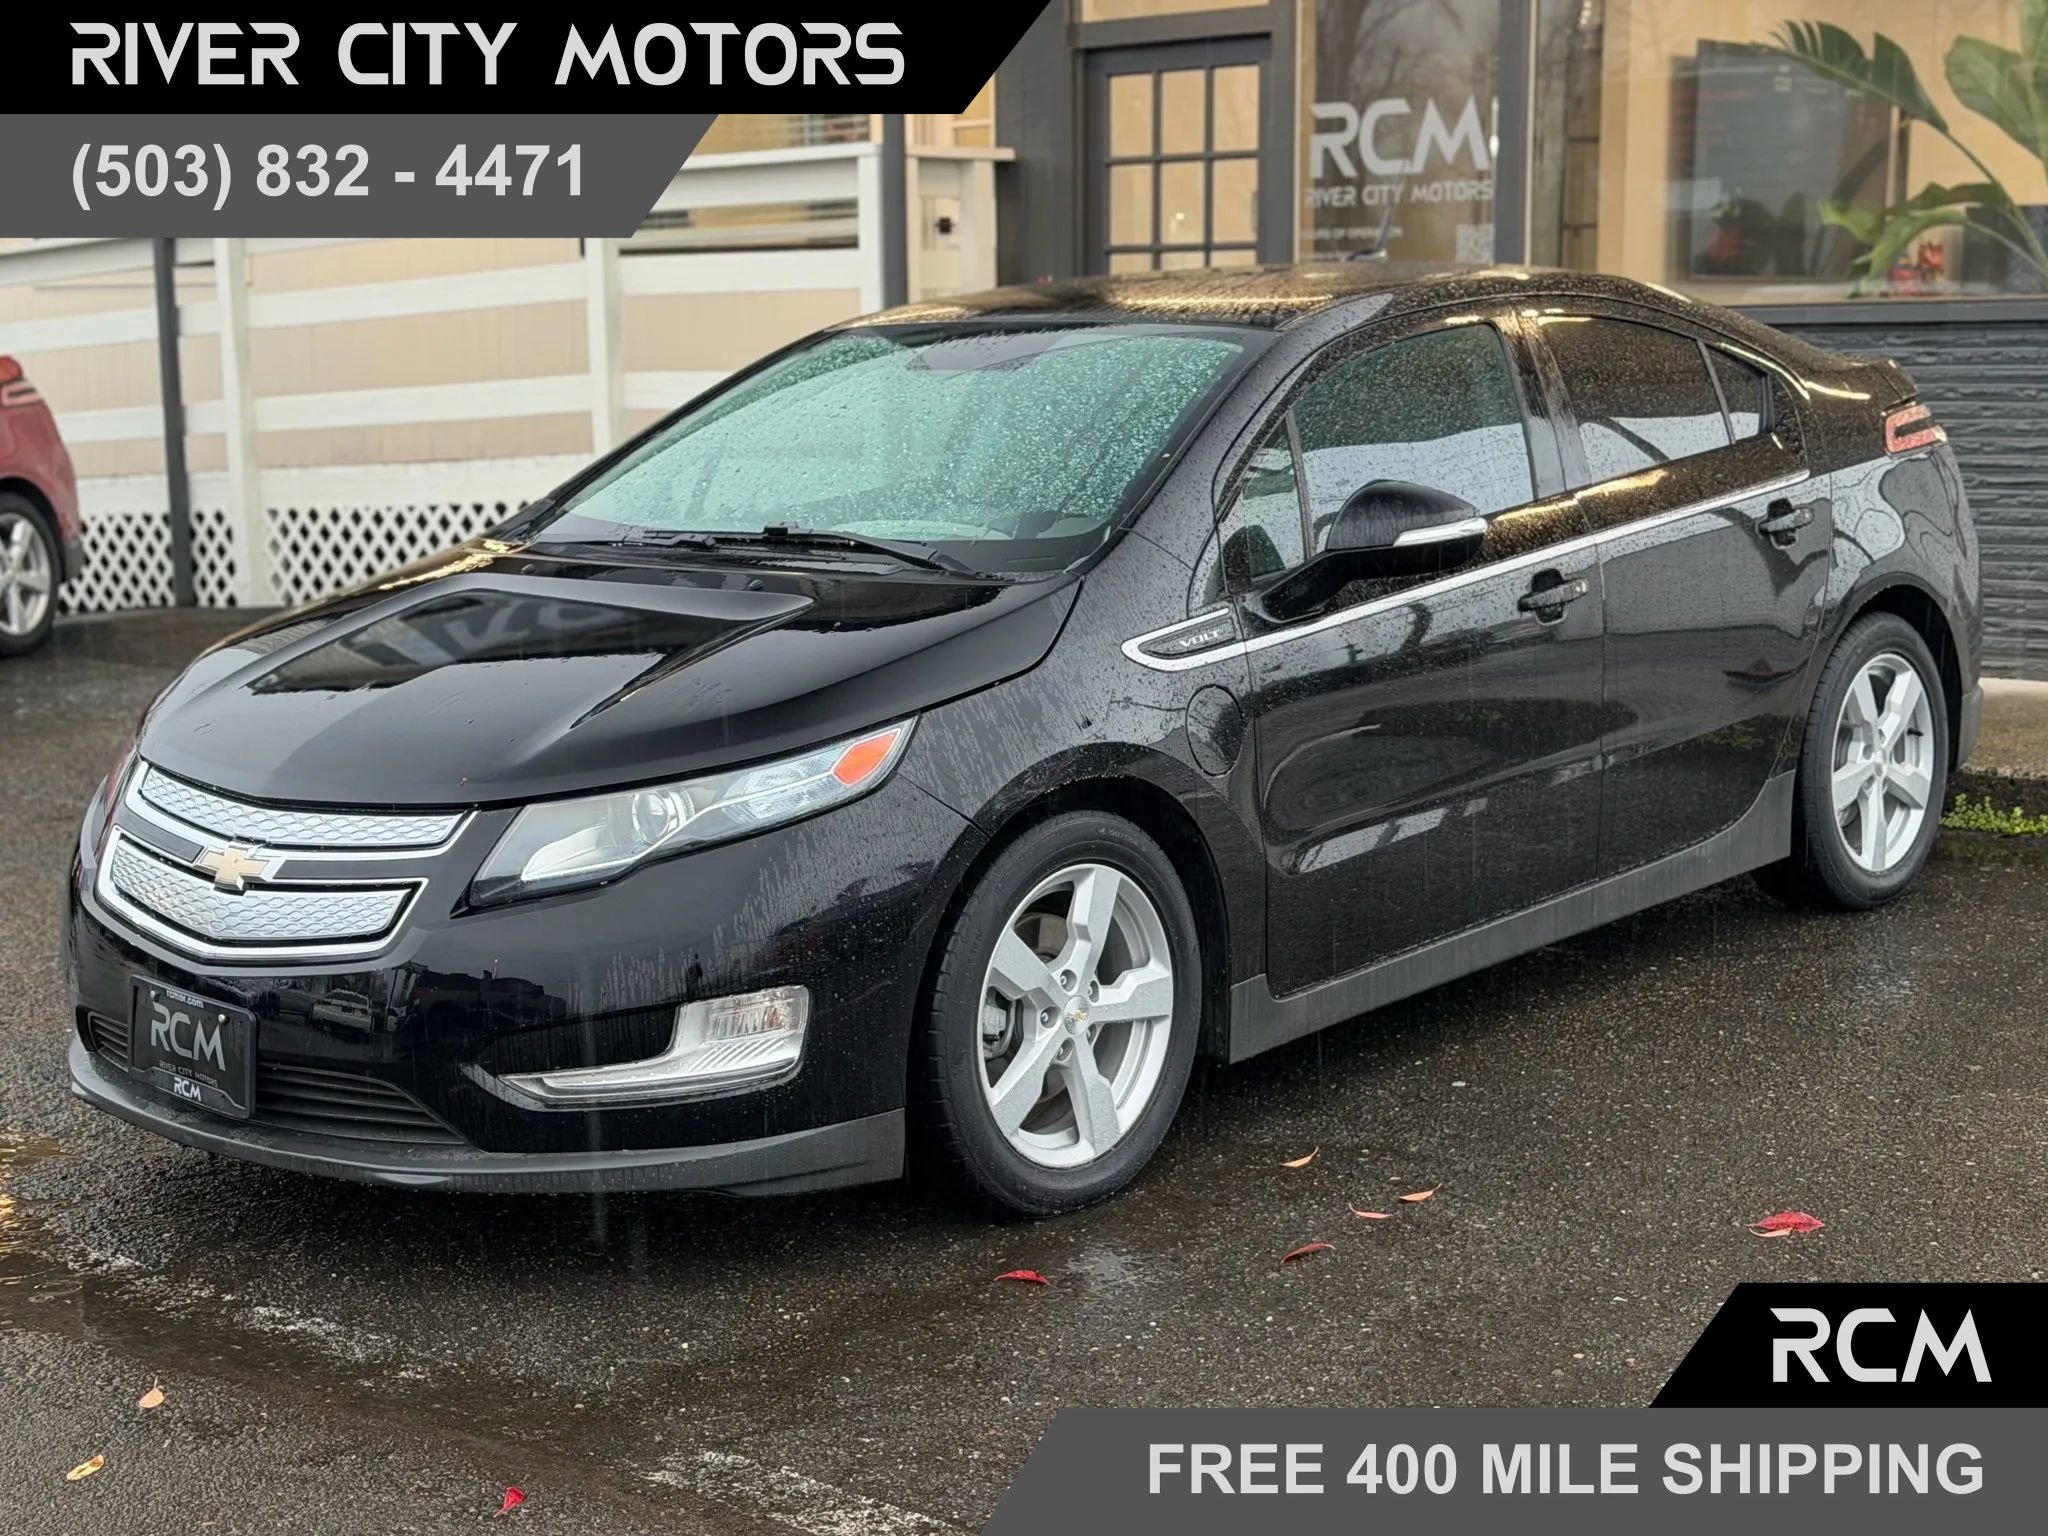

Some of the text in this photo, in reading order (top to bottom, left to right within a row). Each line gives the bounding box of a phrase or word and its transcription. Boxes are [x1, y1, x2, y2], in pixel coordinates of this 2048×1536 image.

[1310, 95, 1490, 179] RCM
[1305, 181, 1493, 208] RIVER CITY MOTORS
[1179, 629, 1220, 648] VOLT
[151, 1001, 226, 1072] RCM
[177, 1066, 193, 1077] CITY
[173, 1076, 202, 1102] RCM
